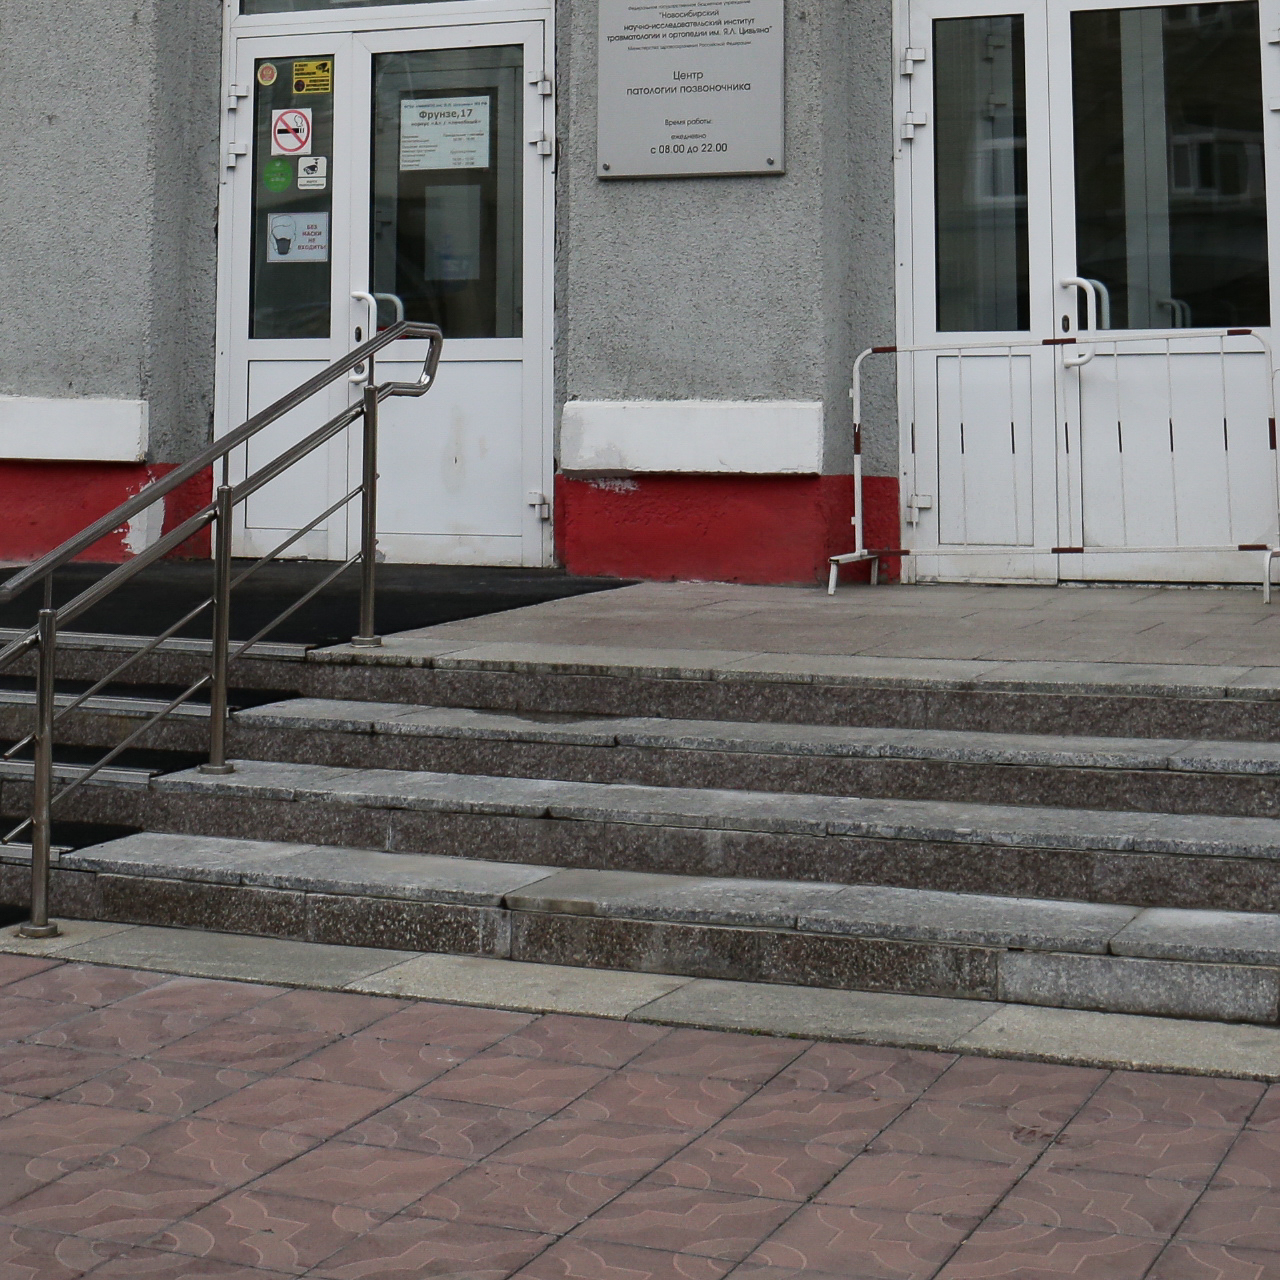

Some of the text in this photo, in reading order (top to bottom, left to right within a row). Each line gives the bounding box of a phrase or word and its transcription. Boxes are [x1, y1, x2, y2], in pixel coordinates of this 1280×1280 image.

[723, 17, 755, 26] институт
[607, 32, 661, 43] травматологии
[668, 30, 708, 40] ортопедии
[673, 70, 704, 81] Центр
[626, 82, 751, 96] патологии позвоночника
[418, 108, 473, 121] Фрунзе,17
[658, 144, 685, 154] 08.00
[686, 146, 699, 154] до
[701, 142, 728, 153] 22.00
